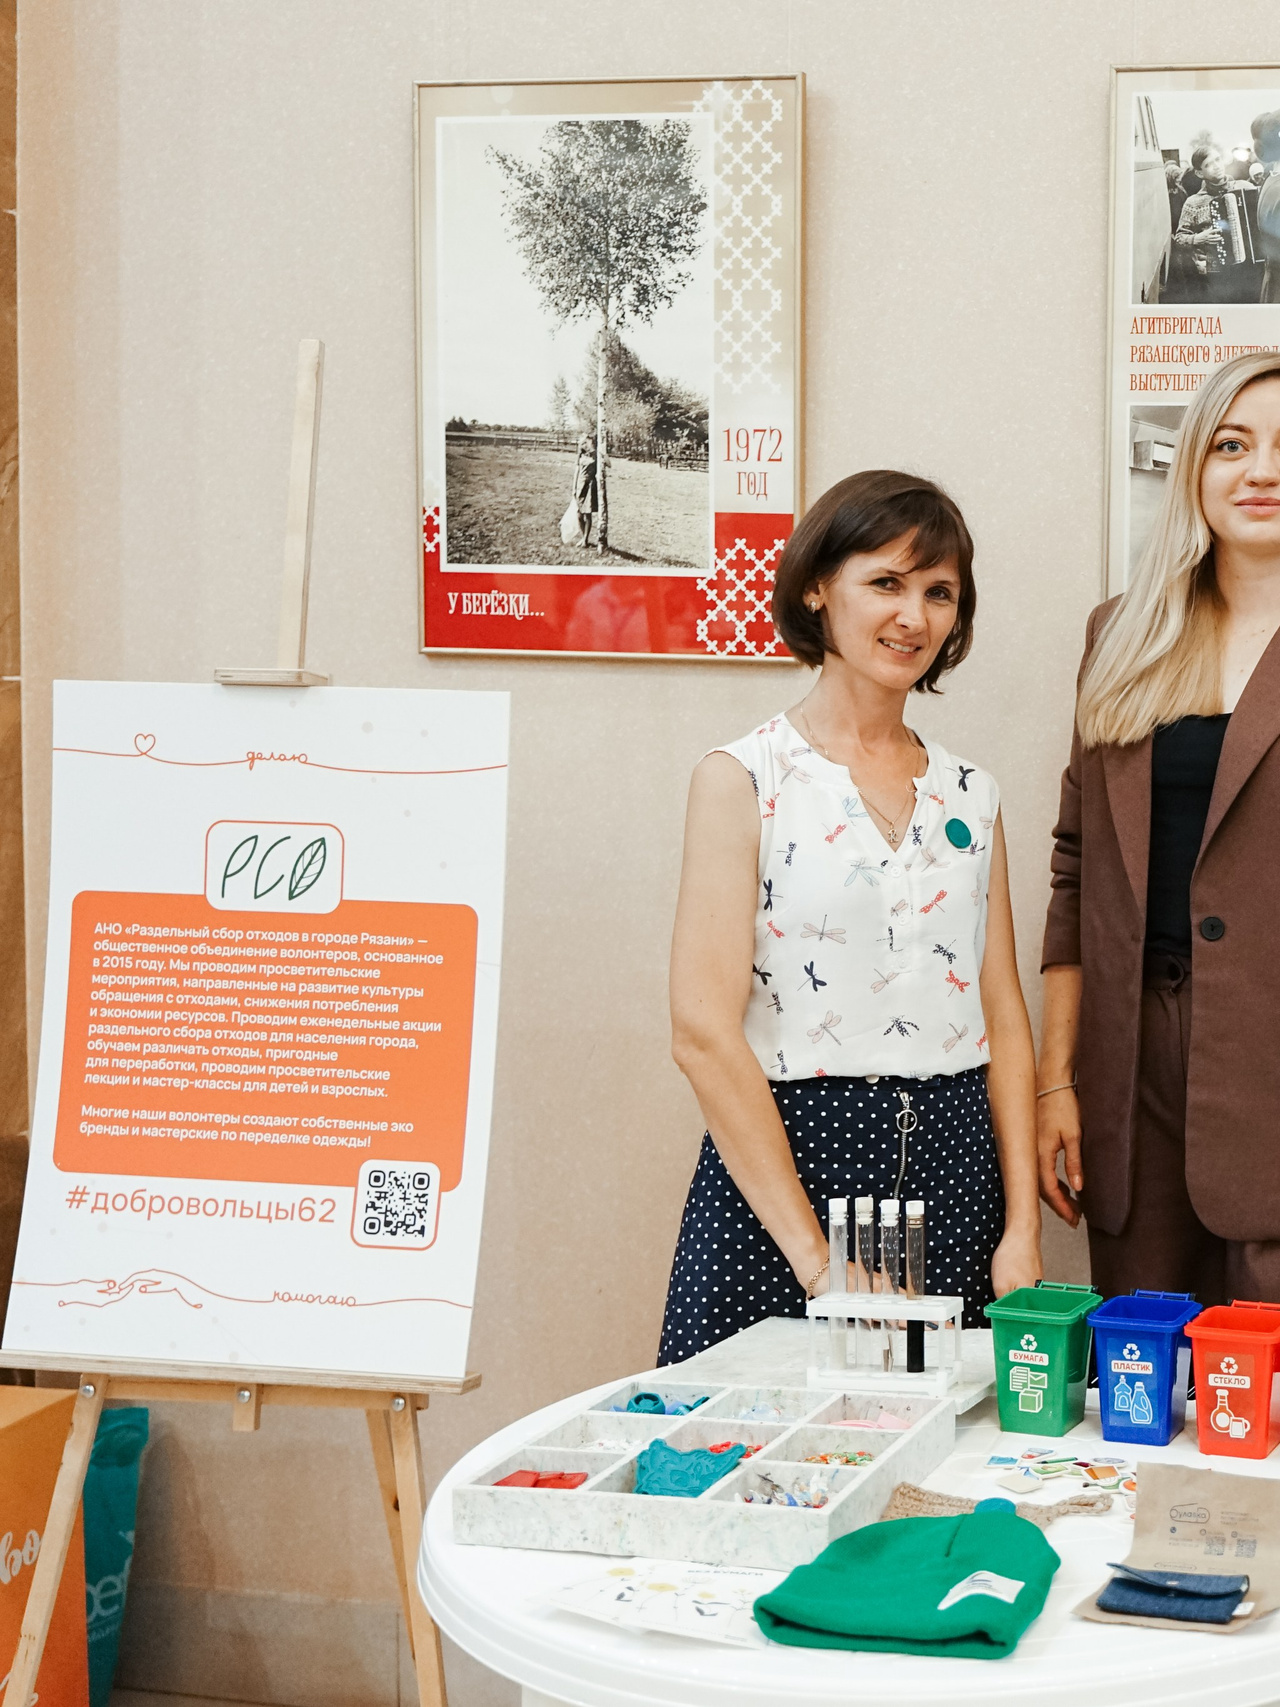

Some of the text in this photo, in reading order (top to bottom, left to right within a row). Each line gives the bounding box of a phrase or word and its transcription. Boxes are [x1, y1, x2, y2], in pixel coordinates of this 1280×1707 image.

[1130, 316, 1223, 336] АГИТБРИГАДА
[1130, 345, 1211, 367] РЯЗАНСКОГО
[723, 427, 784, 463] 1972
[736, 470, 768, 501] ГОД
[447, 590, 545, 620] У БЕРЁЗКИ...
[94, 922, 122, 935] АНО
[125, 924, 210, 938] «Раздельный
[212, 927, 244, 942] сбор
[246, 930, 299, 942] отходов
[301, 933, 309, 942] в
[311, 933, 358, 946] городе
[360, 932, 414, 946] Рязани»
[93, 939, 443, 964] общественное объединение волонтеров, основанное
[93, 955, 381, 979] в 2015 году. Мы проводим просветительские
[92, 974, 424, 1000] мероприятия, направленные на развитие культуры
[90, 989, 399, 1014] обращения с отходами, снижения потребления
[90, 1008, 442, 1033] и экономии ресурсов. Проводим еженедельные акции
[88, 1024, 419, 1049] раздельного сбора отходов для населения города,
[87, 1039, 338, 1061] обучаем различать отходы, пригодные
[85, 1057, 390, 1080] для переработки, проводим просветительские
[84, 1074, 388, 1098] лекции и мастер-классы для детей и взрослых.
[81, 1105, 414, 1133] Многие наши волонтеры создают собственные эко
[79, 1121, 371, 1148] бренды и мастерские по переделке одежды!
[65, 1184, 338, 1224] #добровольцы62
[1012, 1352, 1044, 1364] БУМАГА
[1113, 1362, 1151, 1372] ПЛАСТИК
[1213, 1375, 1246, 1386] СТЕКЛО
